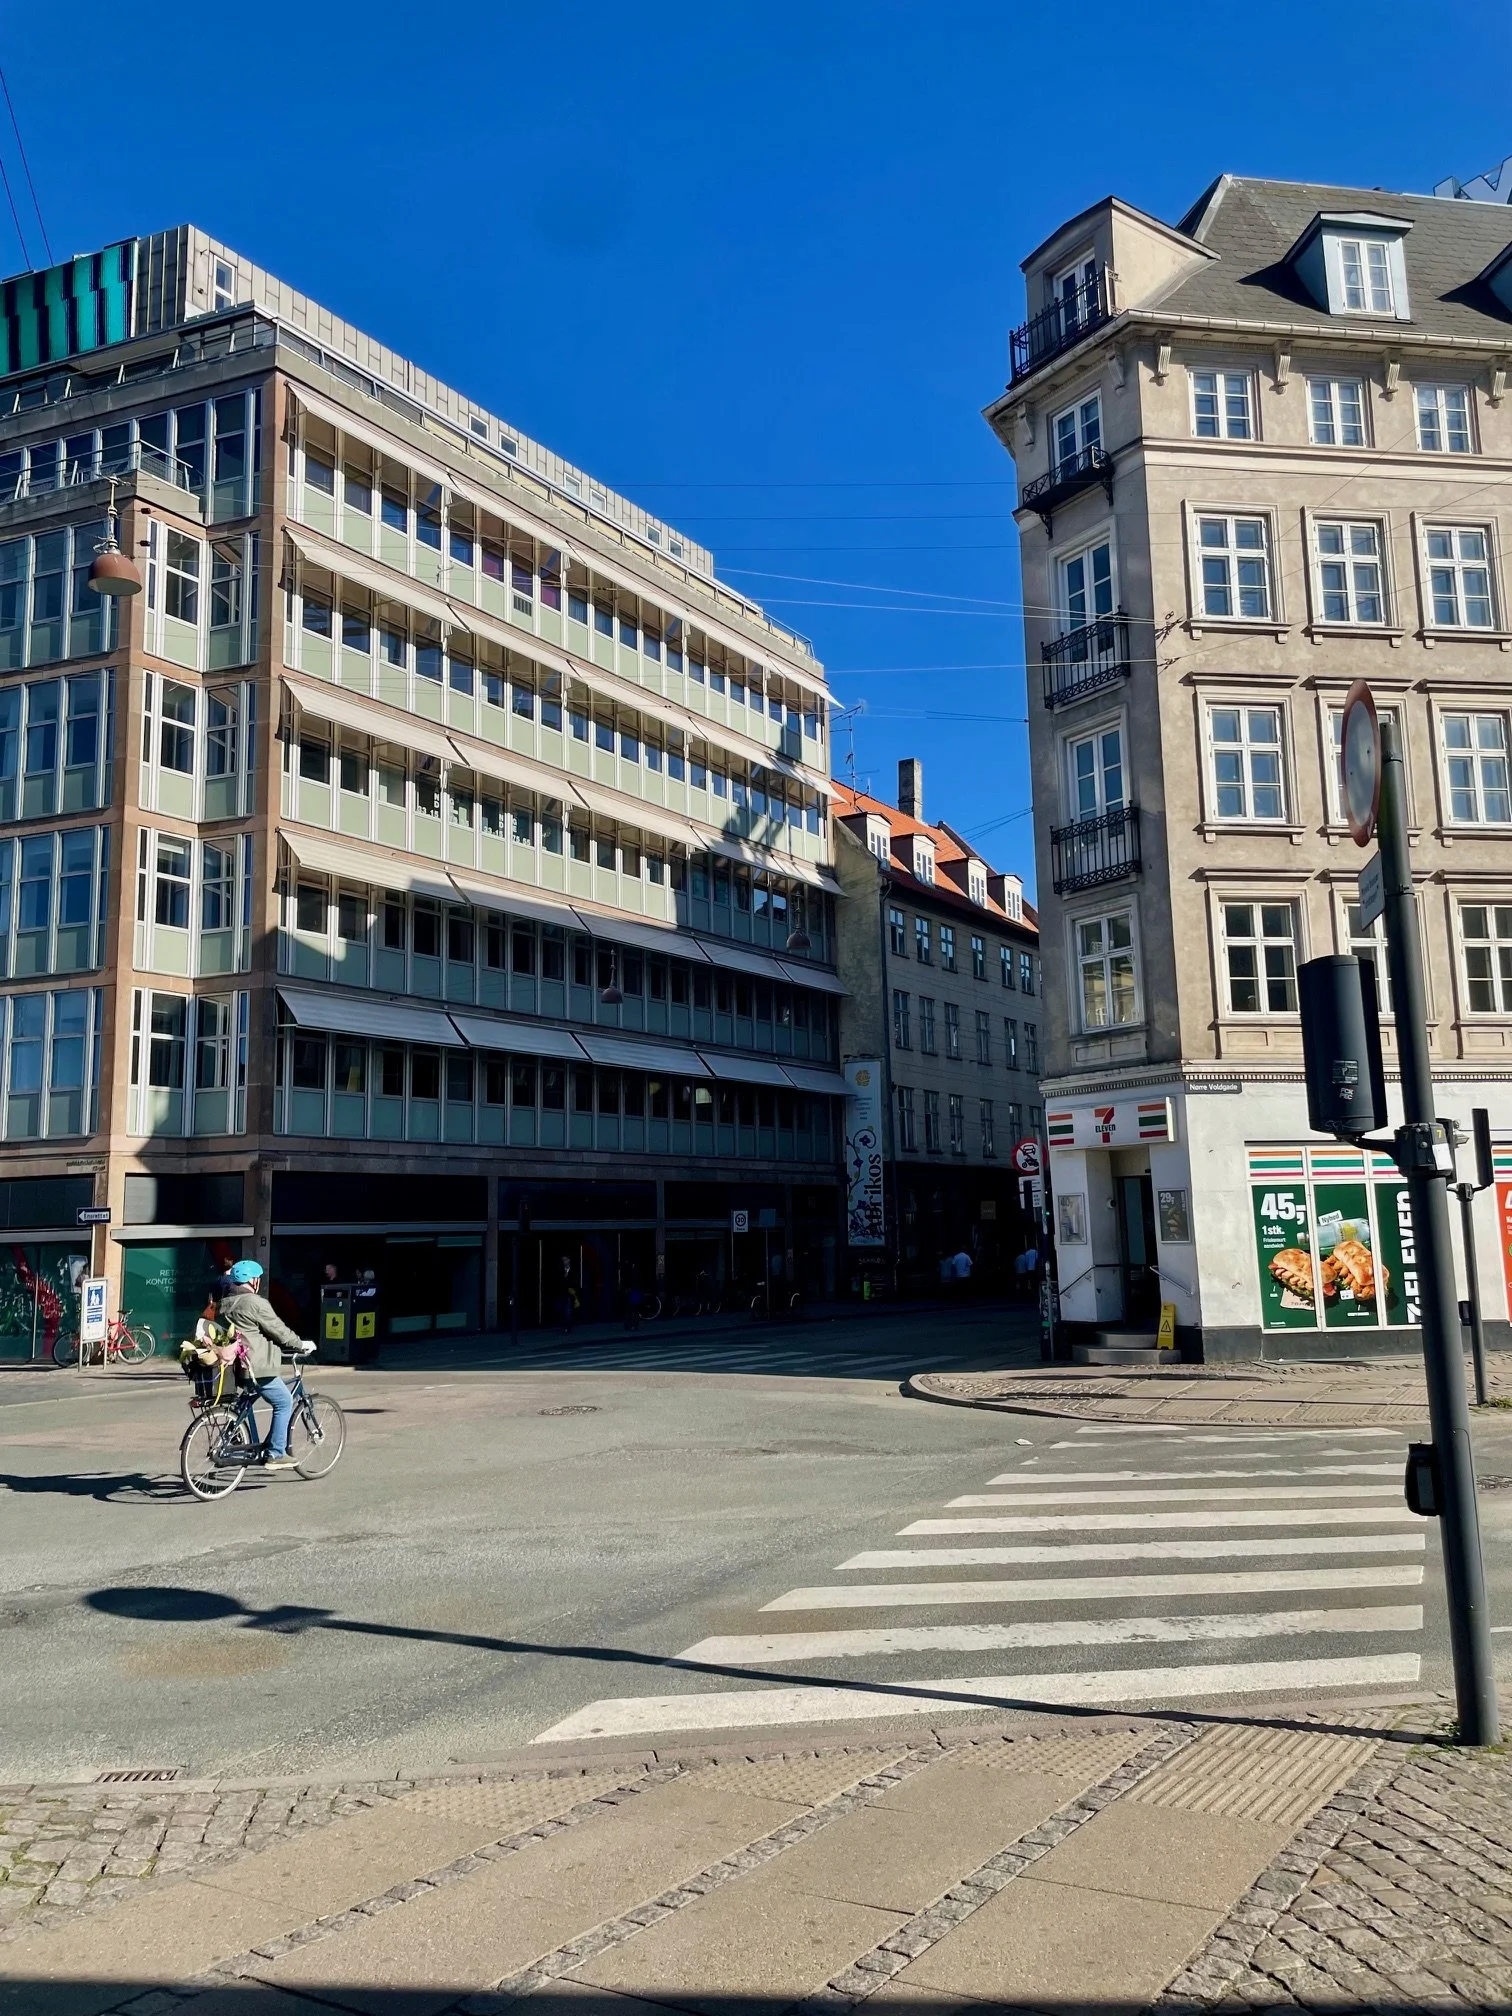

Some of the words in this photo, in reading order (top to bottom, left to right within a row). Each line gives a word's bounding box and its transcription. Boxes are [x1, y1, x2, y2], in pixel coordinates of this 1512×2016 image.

[1208, 1083, 1238, 1092] Voldgade
[1095, 1107, 1115, 1143] 7
[1321, 1212, 1340, 1224] Nyhed
